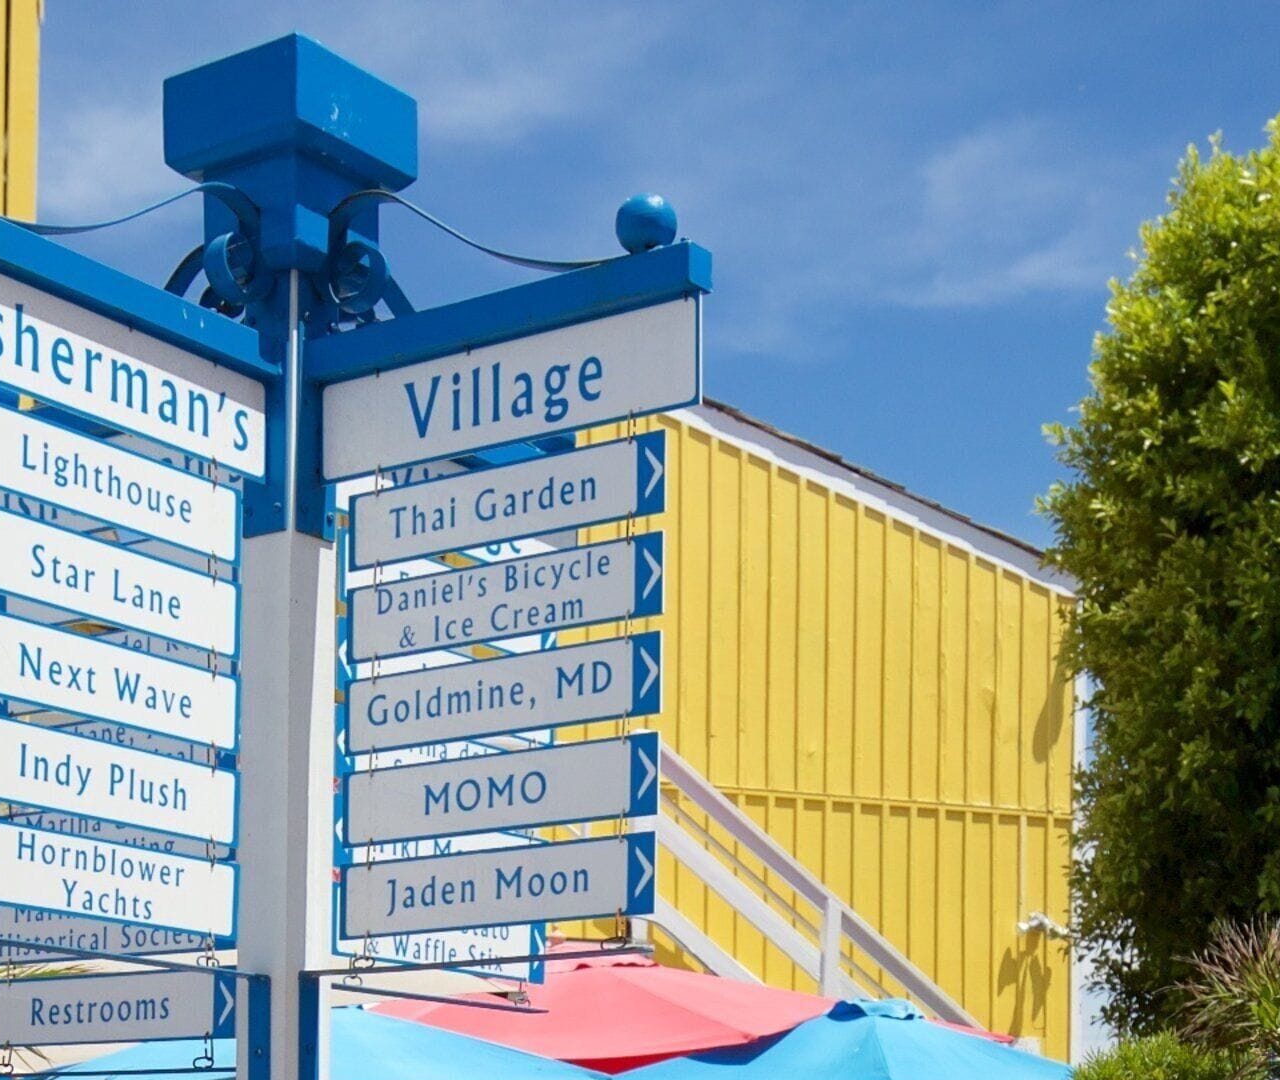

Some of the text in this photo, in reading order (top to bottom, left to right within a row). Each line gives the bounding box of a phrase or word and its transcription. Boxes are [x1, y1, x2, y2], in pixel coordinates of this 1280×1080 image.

[404, 356, 602, 439] Village
[22, 433, 192, 523] Lighthouse
[389, 498, 456, 539] Thai
[474, 476, 596, 522] Garden
[31, 544, 182, 620] Star Lane
[377, 552, 611, 616] Daniel's Bicycle
[399, 598, 584, 648] & Ice Cream
[19, 642, 192, 719] Next Wave
[367, 660, 612, 727] Goldmine, MD
[20, 743, 92, 796] Indy
[109, 763, 187, 811] Plush
[423, 771, 547, 816] MOMO
[17, 831, 185, 888] Hornblower
[62, 878, 152, 920] Yachts
[386, 866, 589, 917] Jaden Moon
[393, 935, 457, 962] Waffle
[30, 996, 170, 1027] Restrooms
